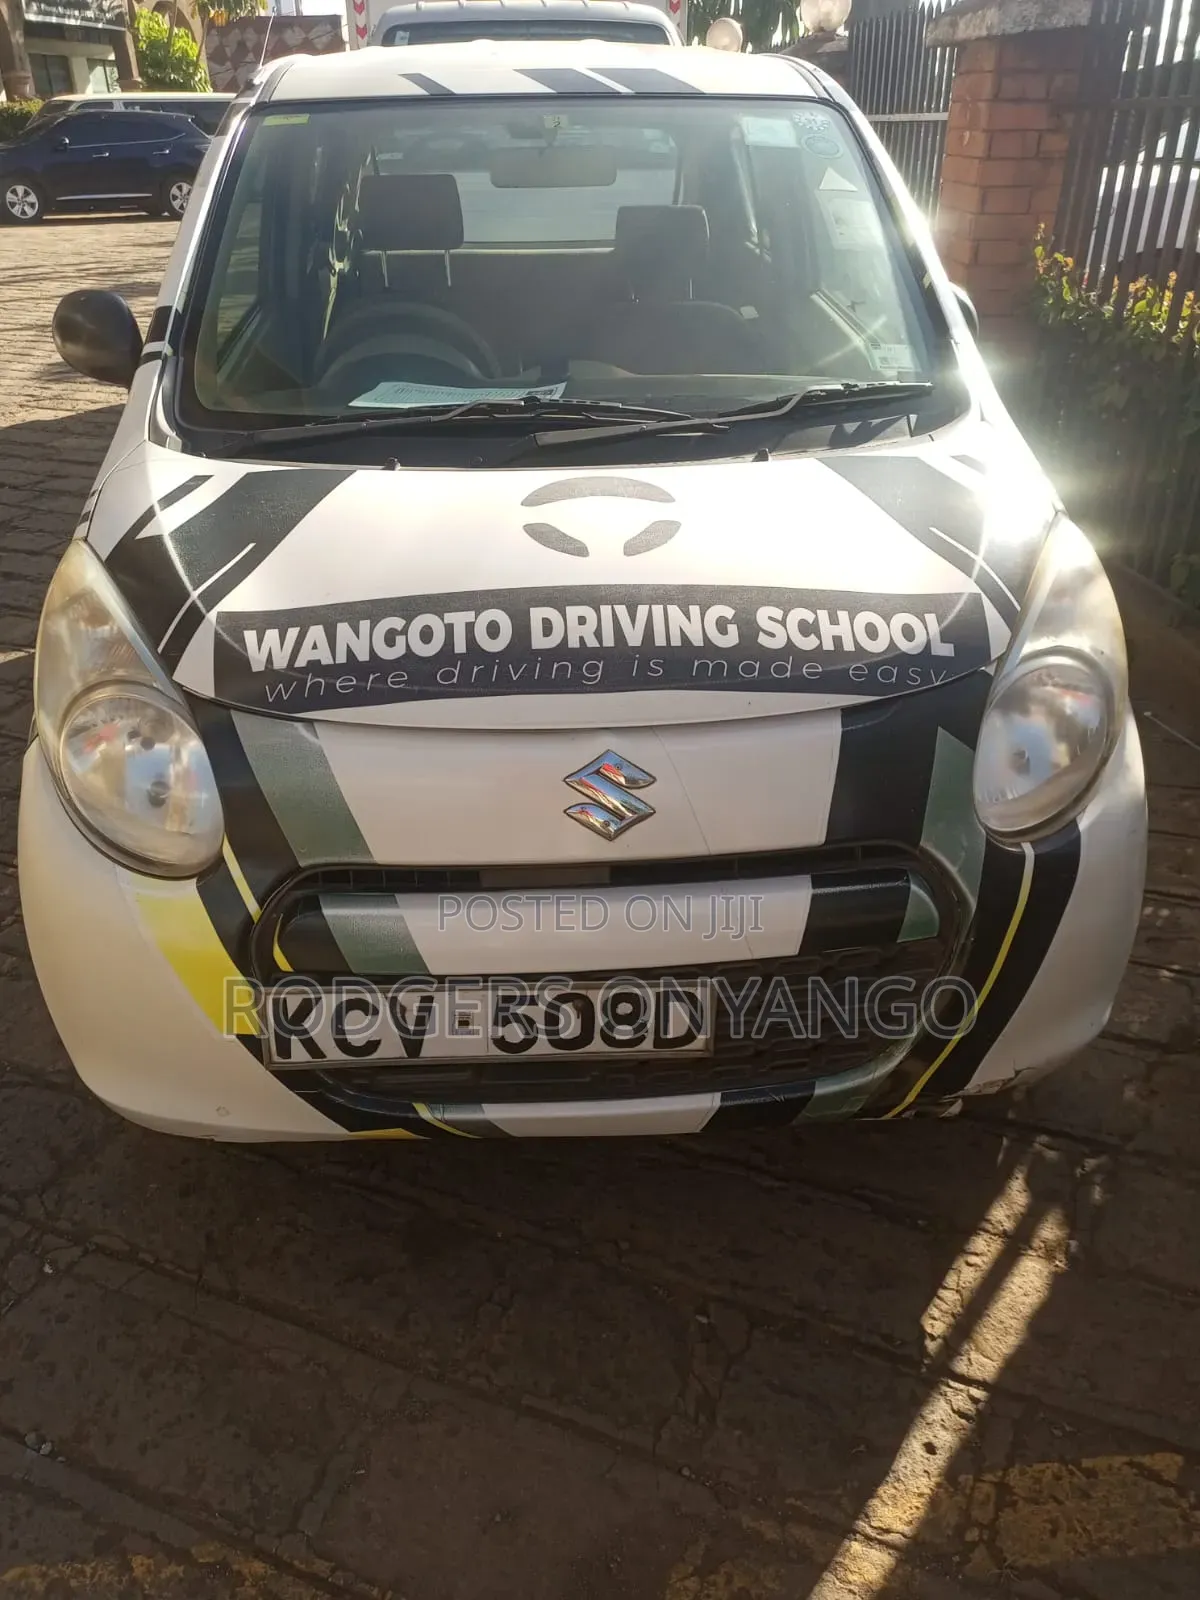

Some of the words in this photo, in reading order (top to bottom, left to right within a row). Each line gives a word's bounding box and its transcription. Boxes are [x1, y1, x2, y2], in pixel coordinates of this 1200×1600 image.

[243, 608, 512, 672] WANGOTO
[529, 604, 740, 649] DRIVING
[756, 606, 955, 657] SCHOOL
[265, 668, 408, 703] where
[437, 656, 604, 685] driving
[632, 654, 664, 678] is
[692, 655, 823, 680] made
[272, 995, 434, 1060] KCV
[491, 990, 705, 1054] 508D
